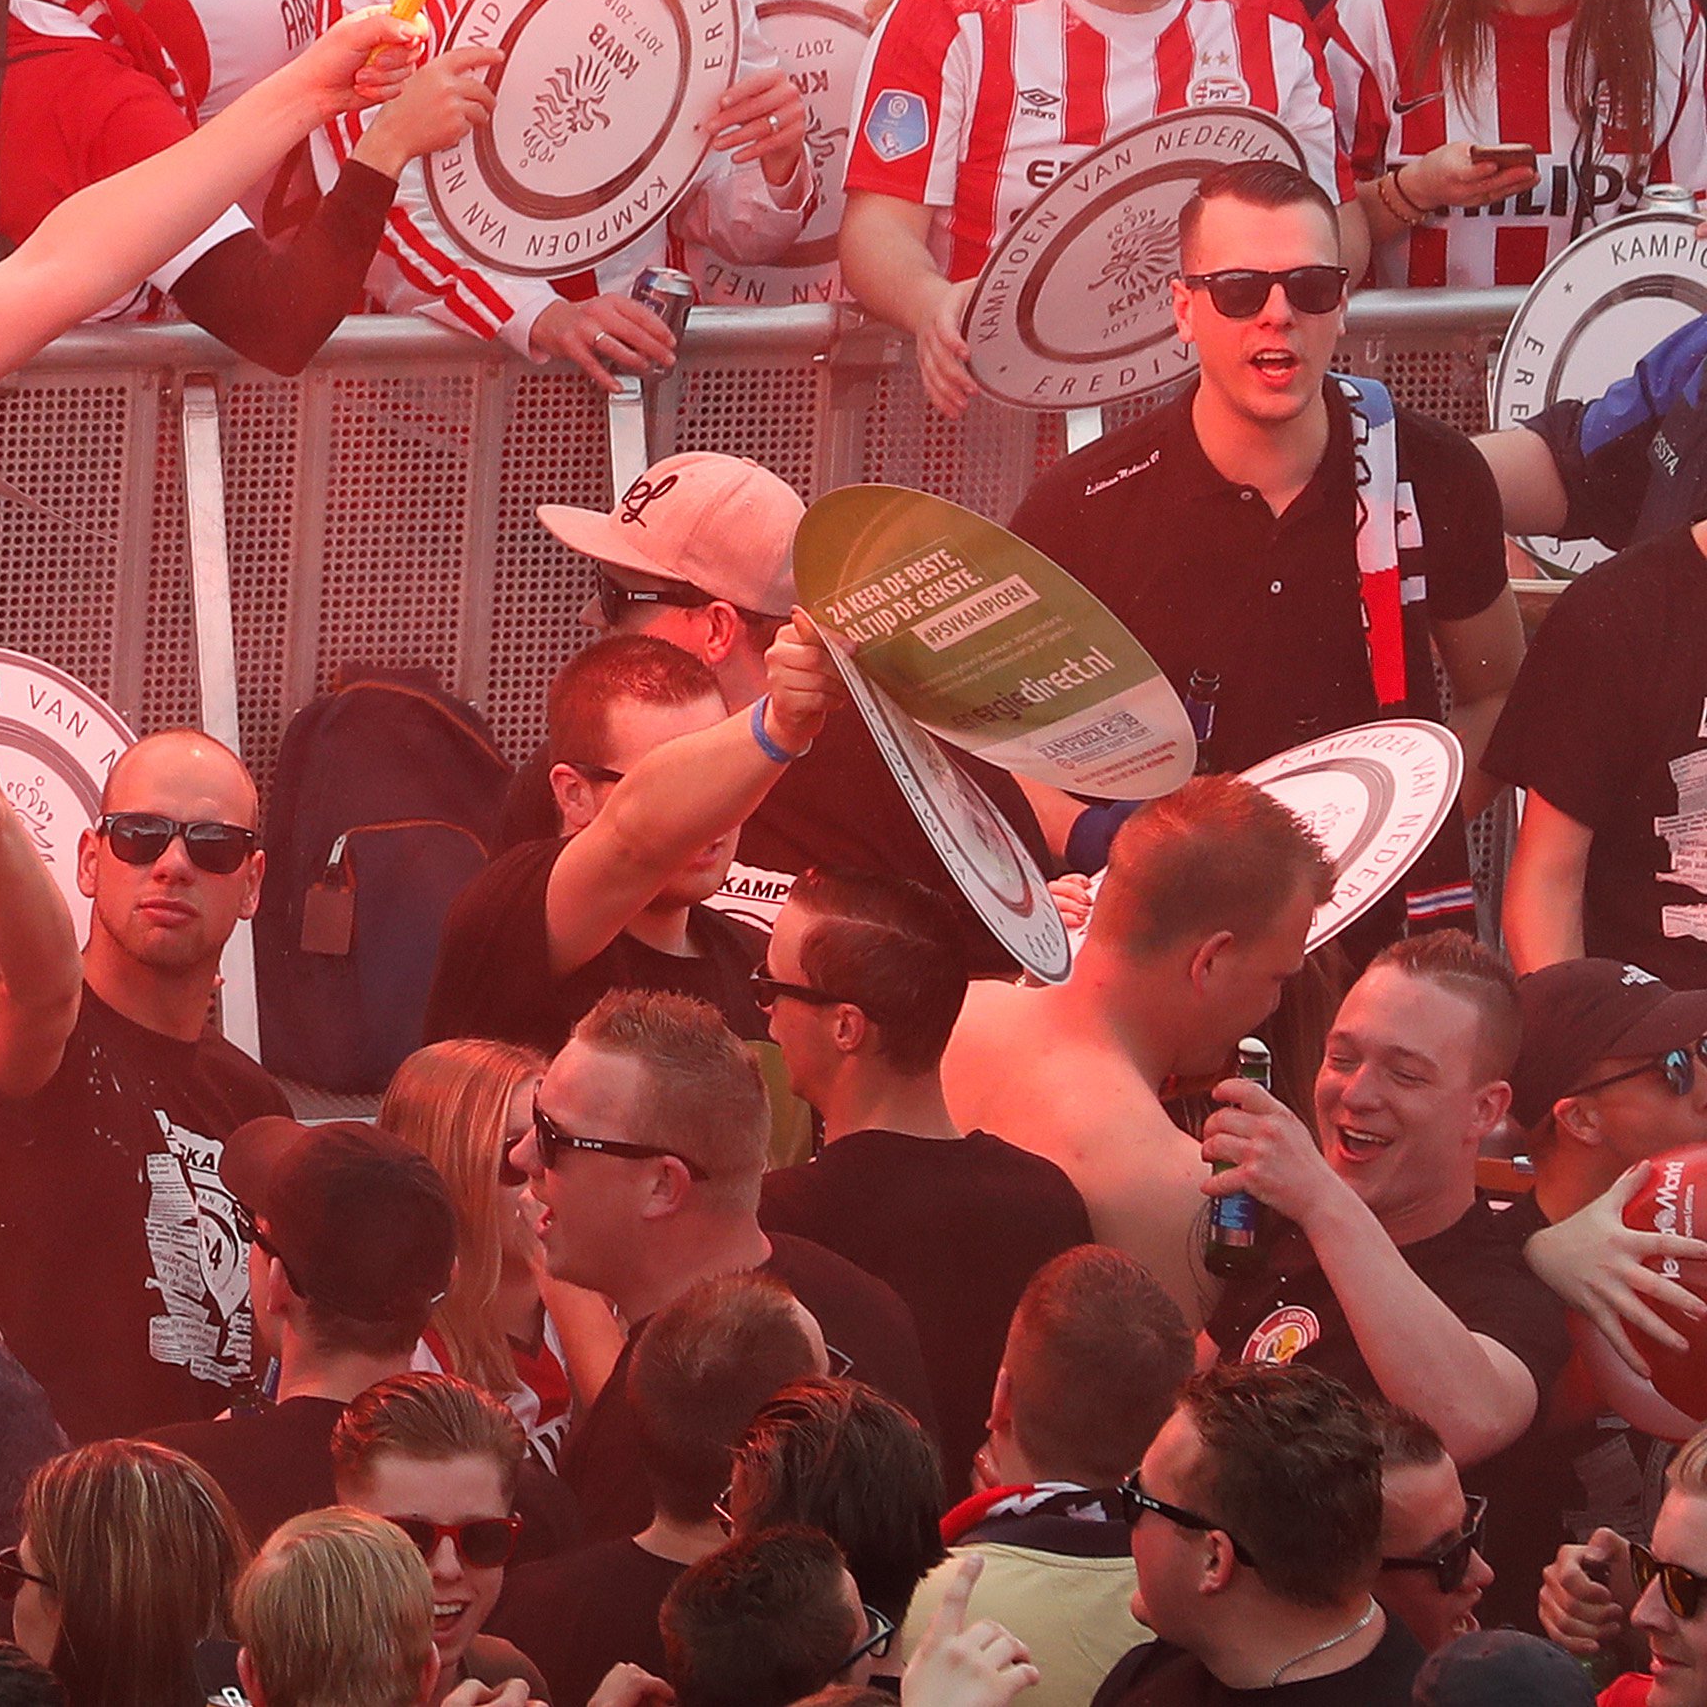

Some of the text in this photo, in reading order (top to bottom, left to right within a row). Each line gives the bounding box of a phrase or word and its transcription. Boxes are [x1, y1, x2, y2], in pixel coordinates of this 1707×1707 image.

[588, 22, 642, 81] KNVB
[636, 27, 666, 57] 2017
[794, 39, 835, 59] 2017
[1019, 106, 1058, 121] umbro
[1208, 89, 1229, 101] PSV
[463, 175, 669, 256] KAMPIOEN VAN
[977, 210, 1060, 345] KAMPIOEN
[1072, 149, 1133, 193] VAN
[1154, 125, 1281, 164] NEDERLA
[1611, 234, 1707, 268] KAMPI
[1101, 311, 1142, 337] 2017
[826, 548, 963, 626] 24 KEER DE BESTE,
[845, 567, 983, 644] ALTIJD DE GEKSTE.
[923, 582, 1030, 645] #PSVKAMPIOEN
[29, 685, 90, 739] VAN
[953, 645, 1116, 730] energiedirect.nl
[1038, 725, 1105, 760] KAMPIOEN
[1277, 733, 1436, 800] KAMPIOEN VAN
